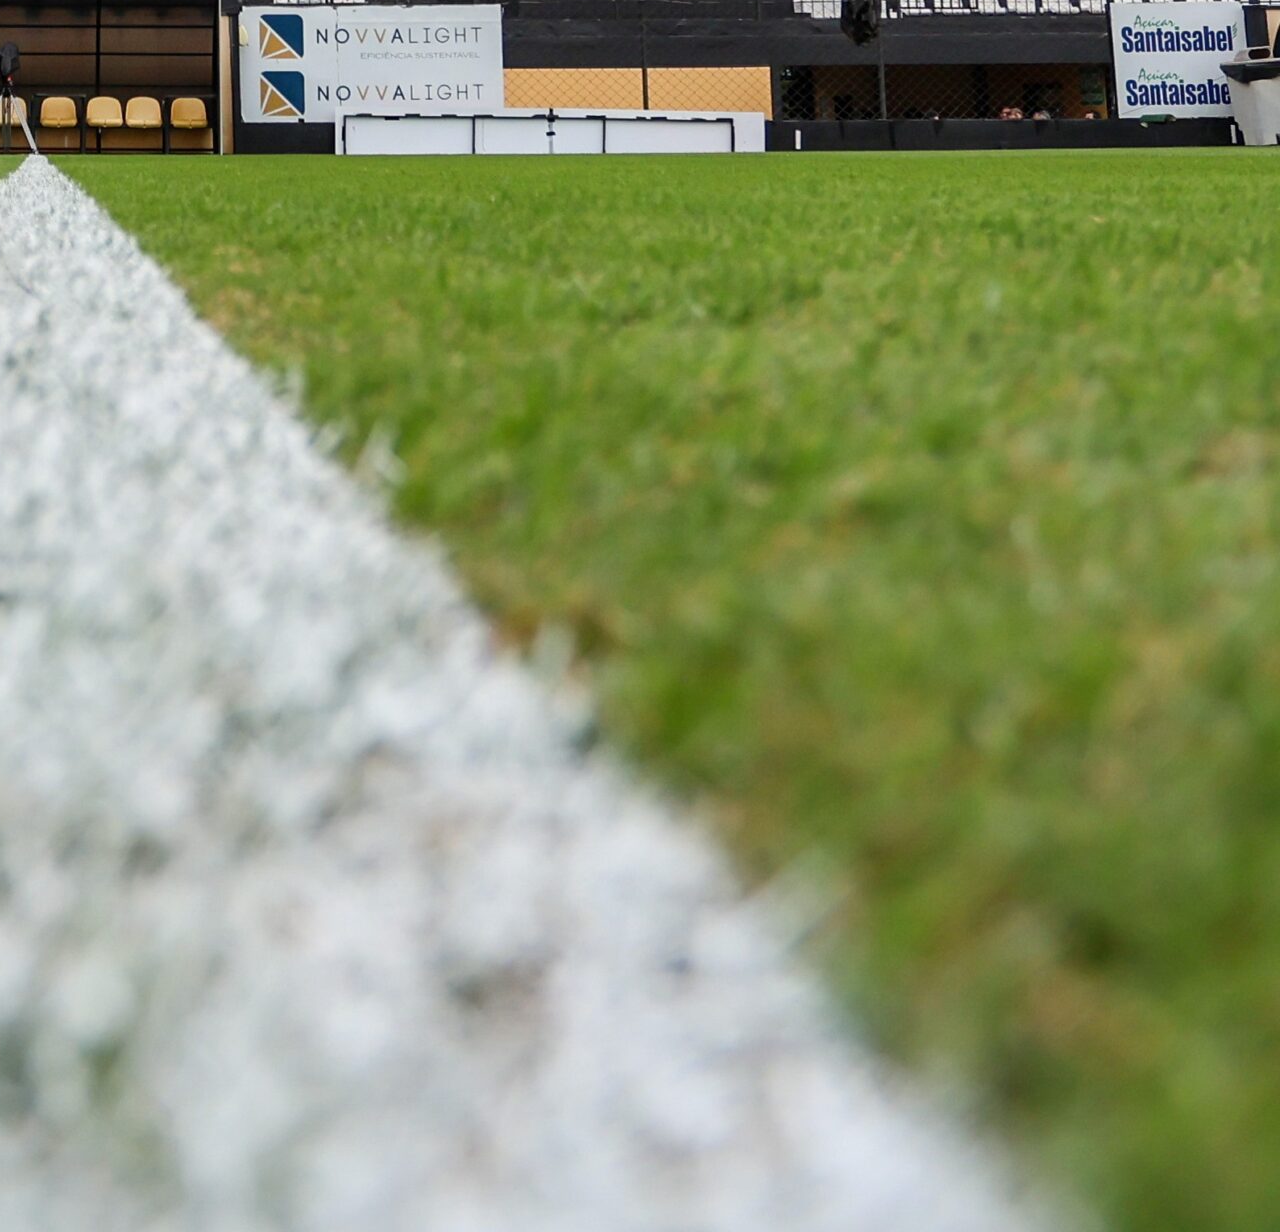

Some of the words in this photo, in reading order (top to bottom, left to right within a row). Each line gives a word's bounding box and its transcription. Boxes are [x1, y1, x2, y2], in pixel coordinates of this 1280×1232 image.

[1133, 14, 1176, 30] Açúcar
[316, 27, 483, 45] NOVVALIGHT
[1121, 25, 1234, 53] Santaisabel
[317, 84, 484, 101] NOVVALIGHT
[1125, 78, 1232, 106] Santaisabe
